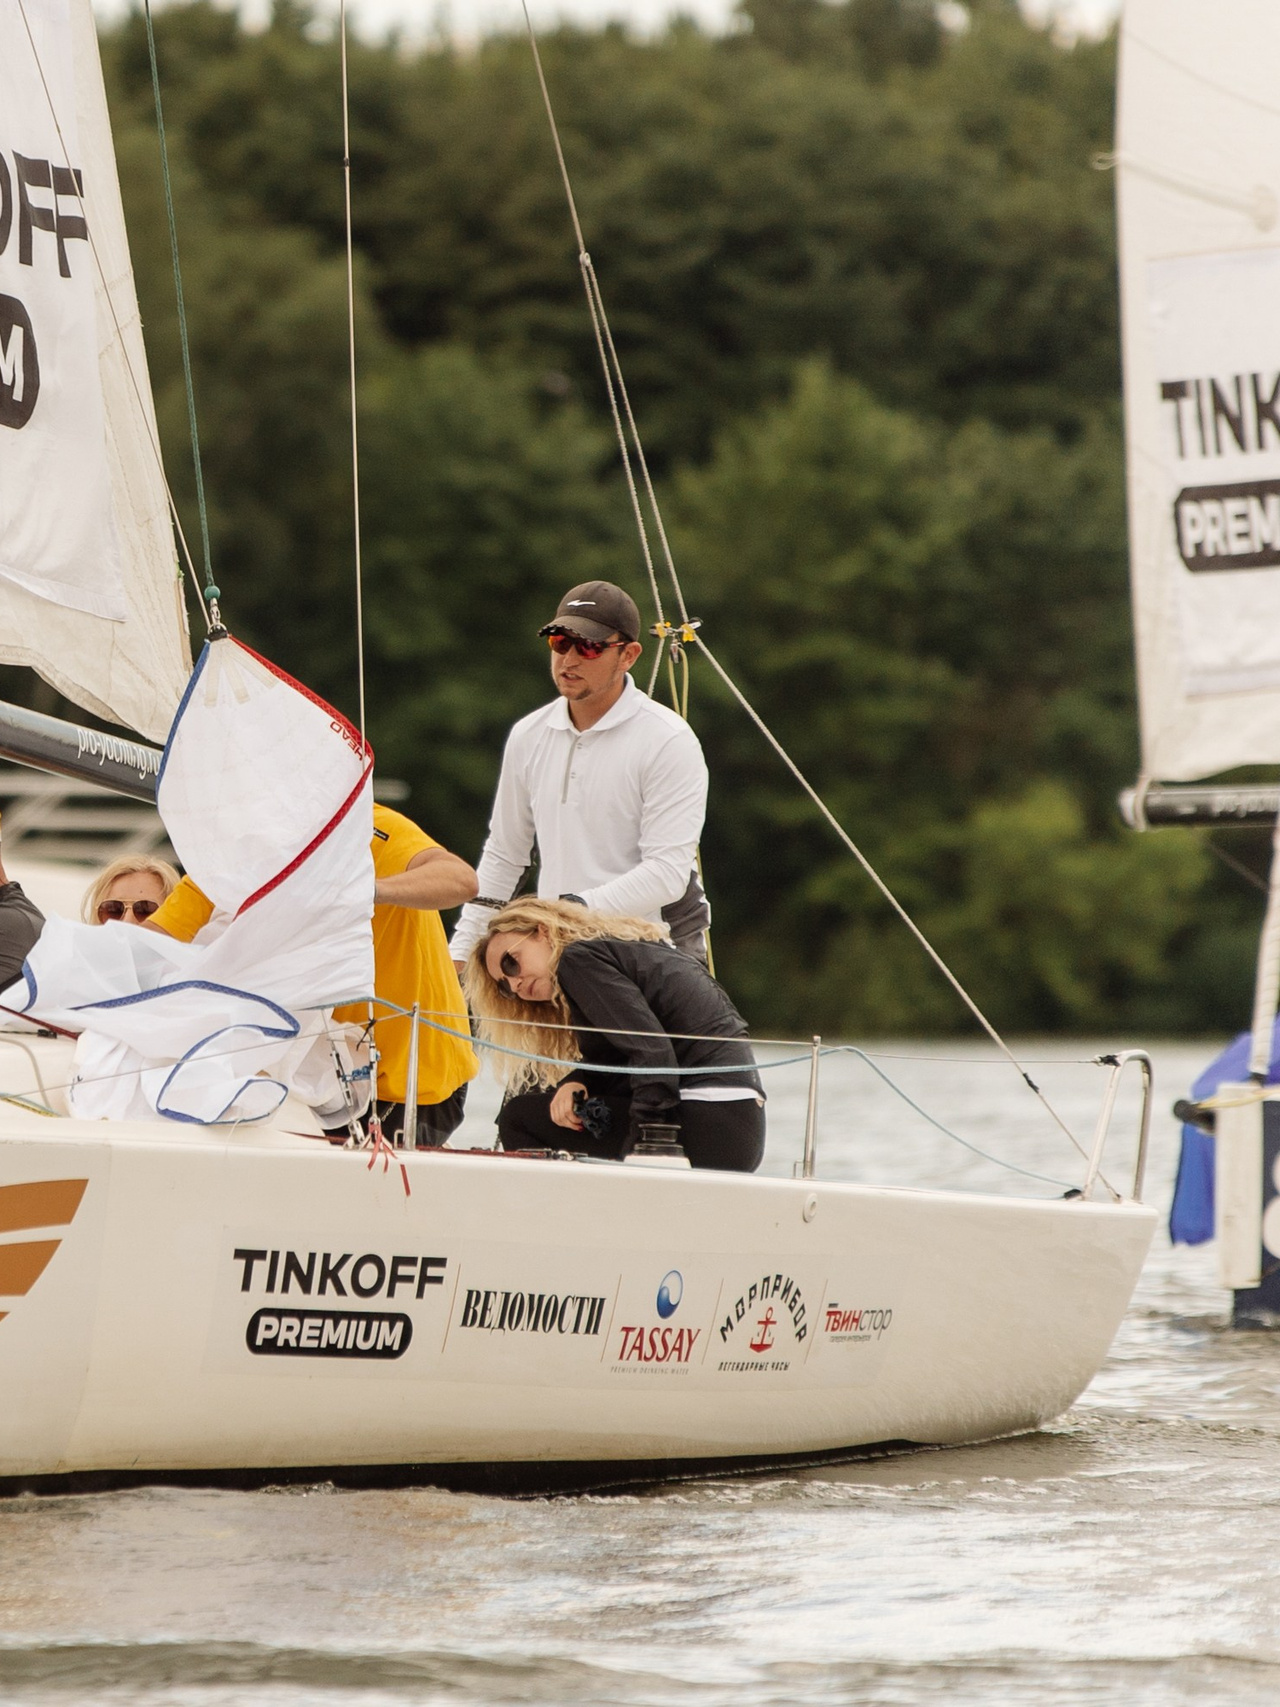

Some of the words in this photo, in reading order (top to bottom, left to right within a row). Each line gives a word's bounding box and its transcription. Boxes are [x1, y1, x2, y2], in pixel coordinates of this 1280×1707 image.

[1160, 372, 1280, 459] TINK
[330, 721, 364, 761] HEAD
[233, 1248, 447, 1300] TINKOFF
[460, 1289, 606, 1336] ВЕДОМОСТИ
[719, 1273, 807, 1343] МОРПРИБОР
[255, 1316, 404, 1351] PREMIUM
[618, 1326, 701, 1363] TASSAY
